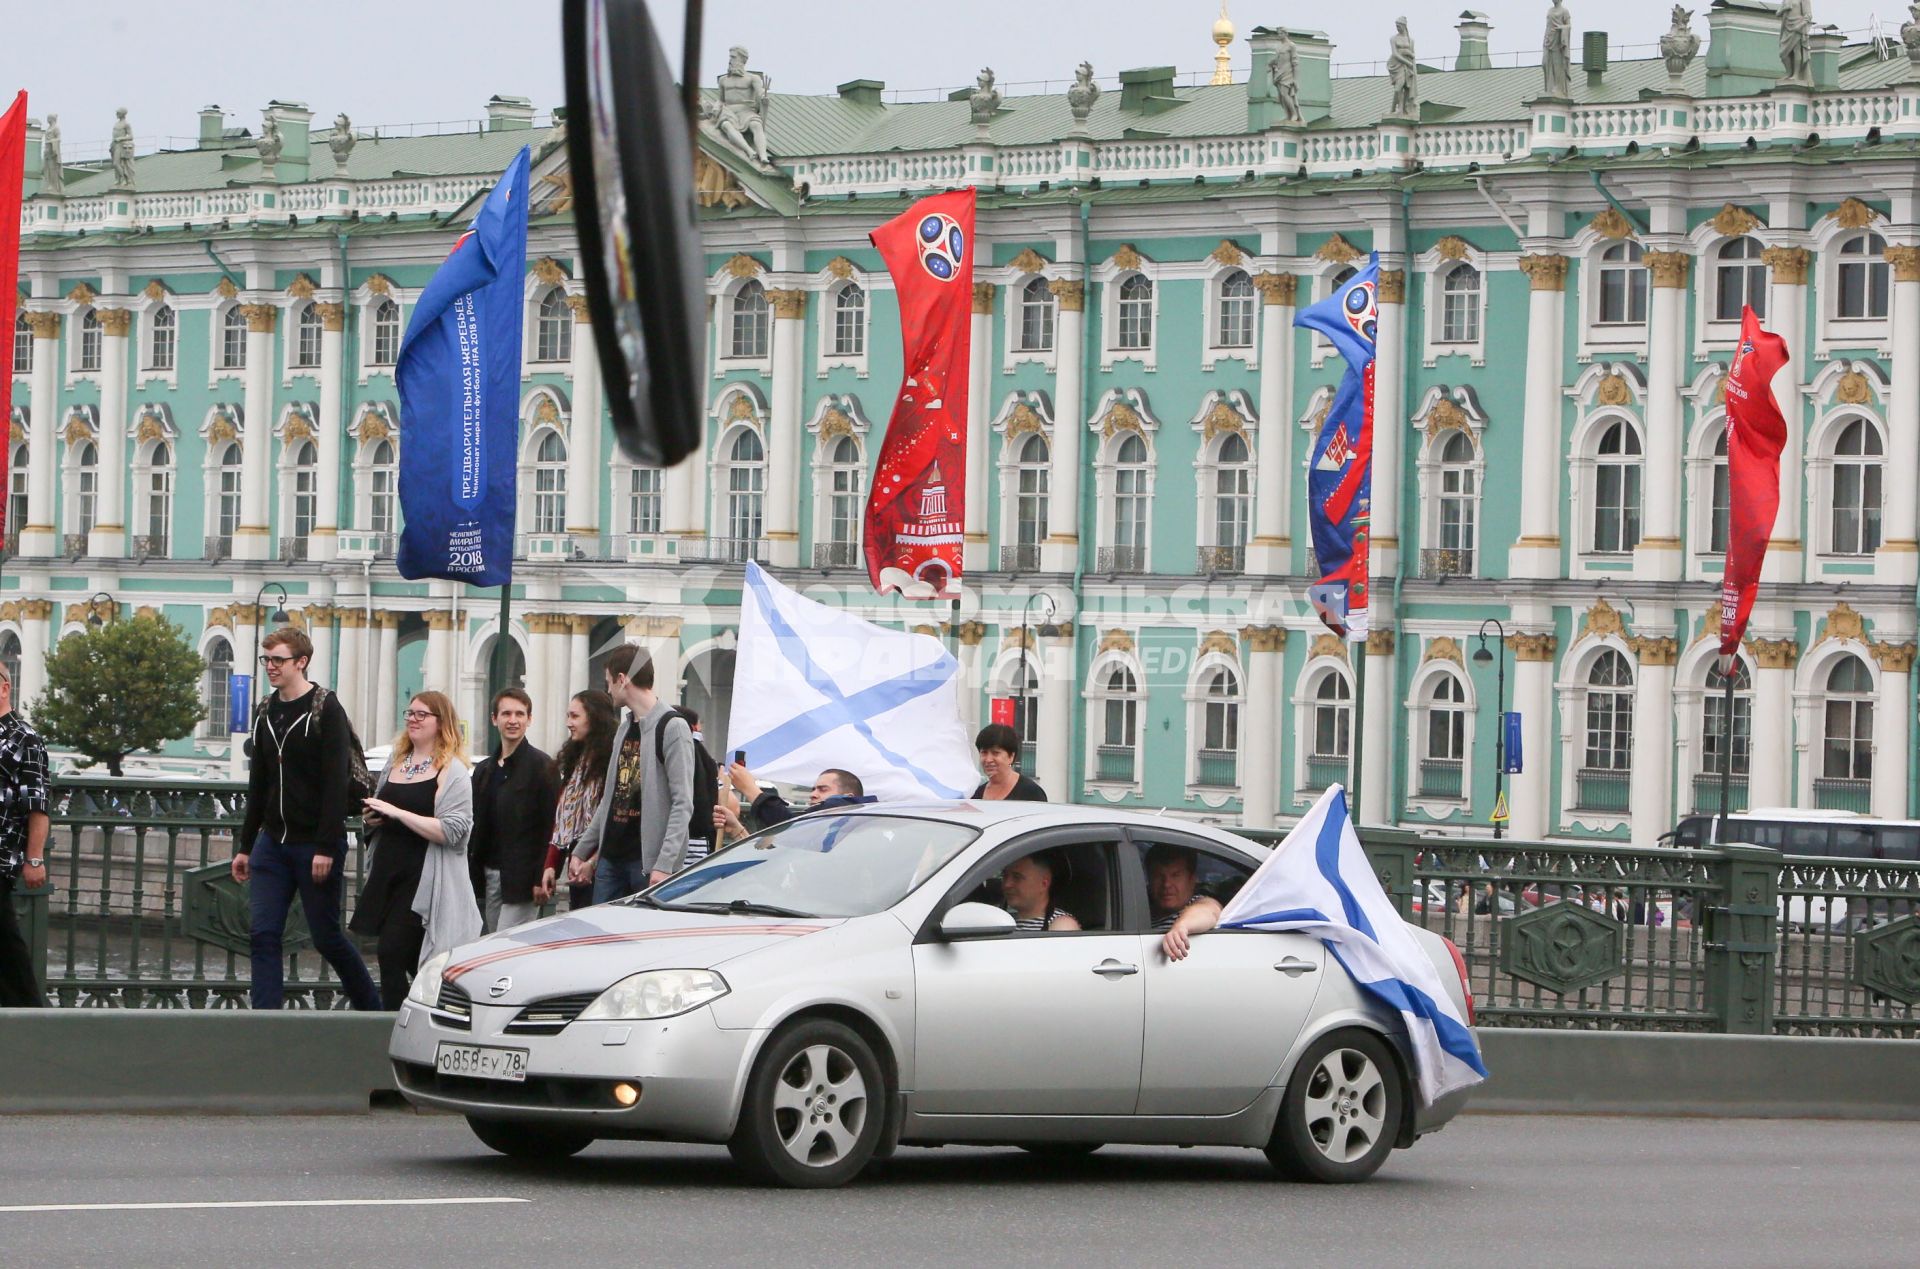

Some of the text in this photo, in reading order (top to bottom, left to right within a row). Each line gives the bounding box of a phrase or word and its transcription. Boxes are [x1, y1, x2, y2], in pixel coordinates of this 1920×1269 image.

[470, 325, 479, 345] 2018
[472, 347, 480, 366] FIFA
[473, 369, 481, 406] футболу
[474, 409, 480, 419] по
[463, 367, 473, 498] ПРЕДВАРИТЕЛЬНАЯ
[472, 447, 480, 497] Чемпионат
[449, 551, 483, 566] 2018
[506, 1053, 521, 1070] 78
[503, 1070, 515, 1078] RUS
